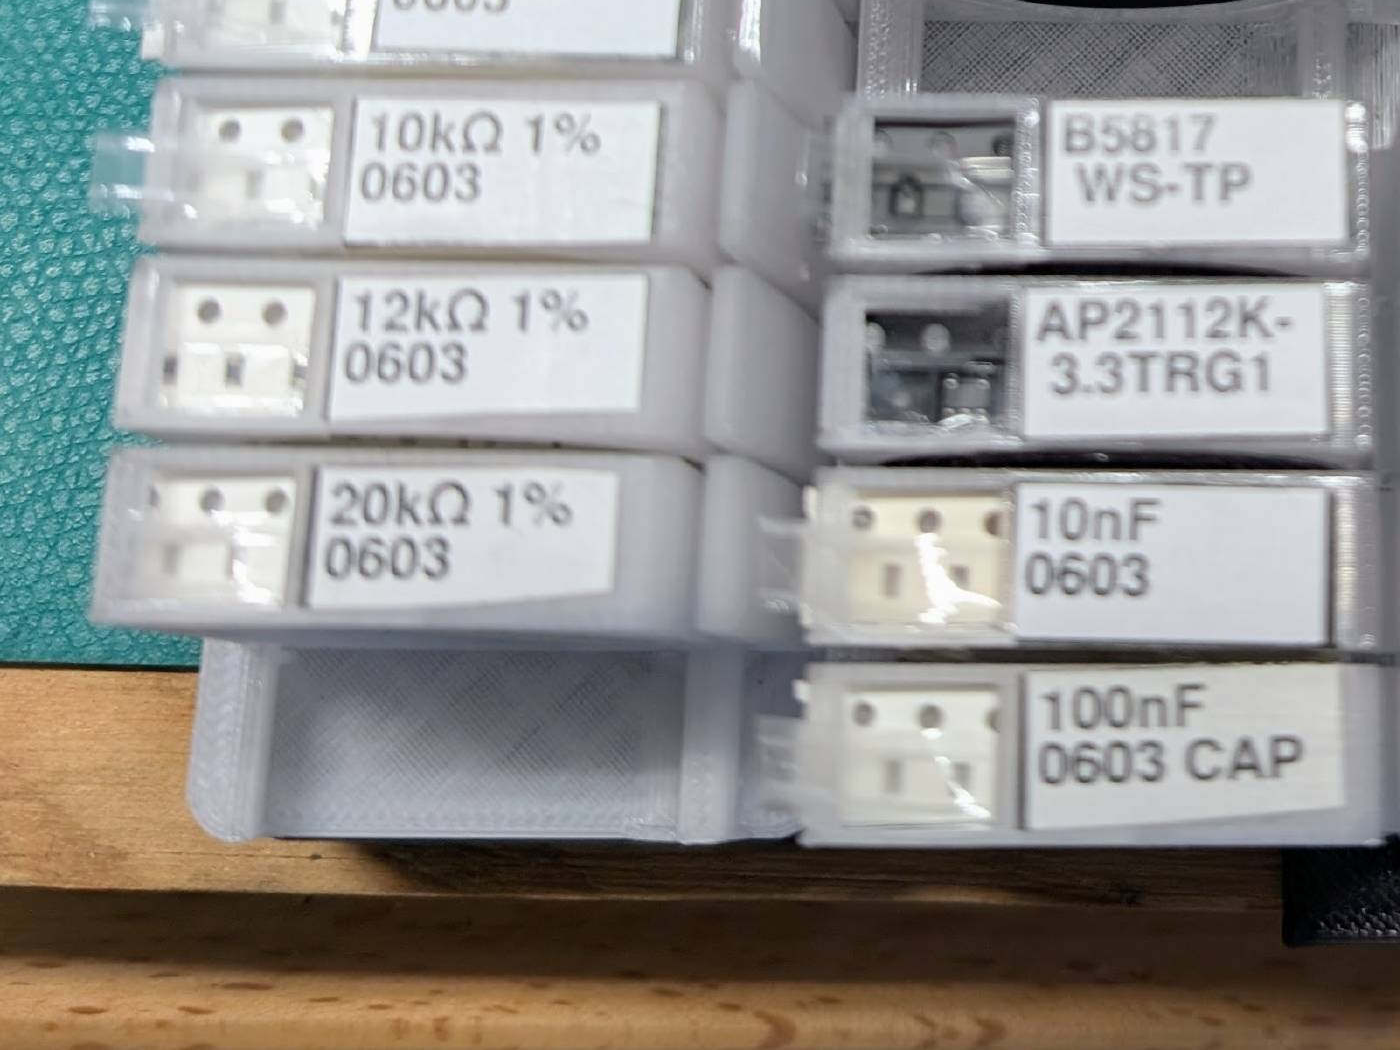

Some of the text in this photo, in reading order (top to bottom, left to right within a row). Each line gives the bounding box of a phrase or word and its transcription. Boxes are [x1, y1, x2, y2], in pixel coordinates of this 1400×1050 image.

[373, 111, 600, 154] 10kΩ 1%
[1062, 114, 1215, 156] B5817
[360, 162, 481, 203] 0603
[1076, 162, 1252, 206] WS-TP
[357, 288, 588, 332] 12kΩ 1%
[1036, 297, 1292, 342] AP2112K-
[344, 344, 467, 384] 0603
[1051, 350, 1269, 397] 3.3TRG1
[330, 481, 572, 526] 20kΩ 1%
[1031, 497, 1160, 543] 10nF
[324, 536, 450, 580] 0603
[1025, 552, 1149, 598] 0603
[1042, 683, 1206, 731] 100nF
[1038, 736, 1303, 786] 0603 CAP
